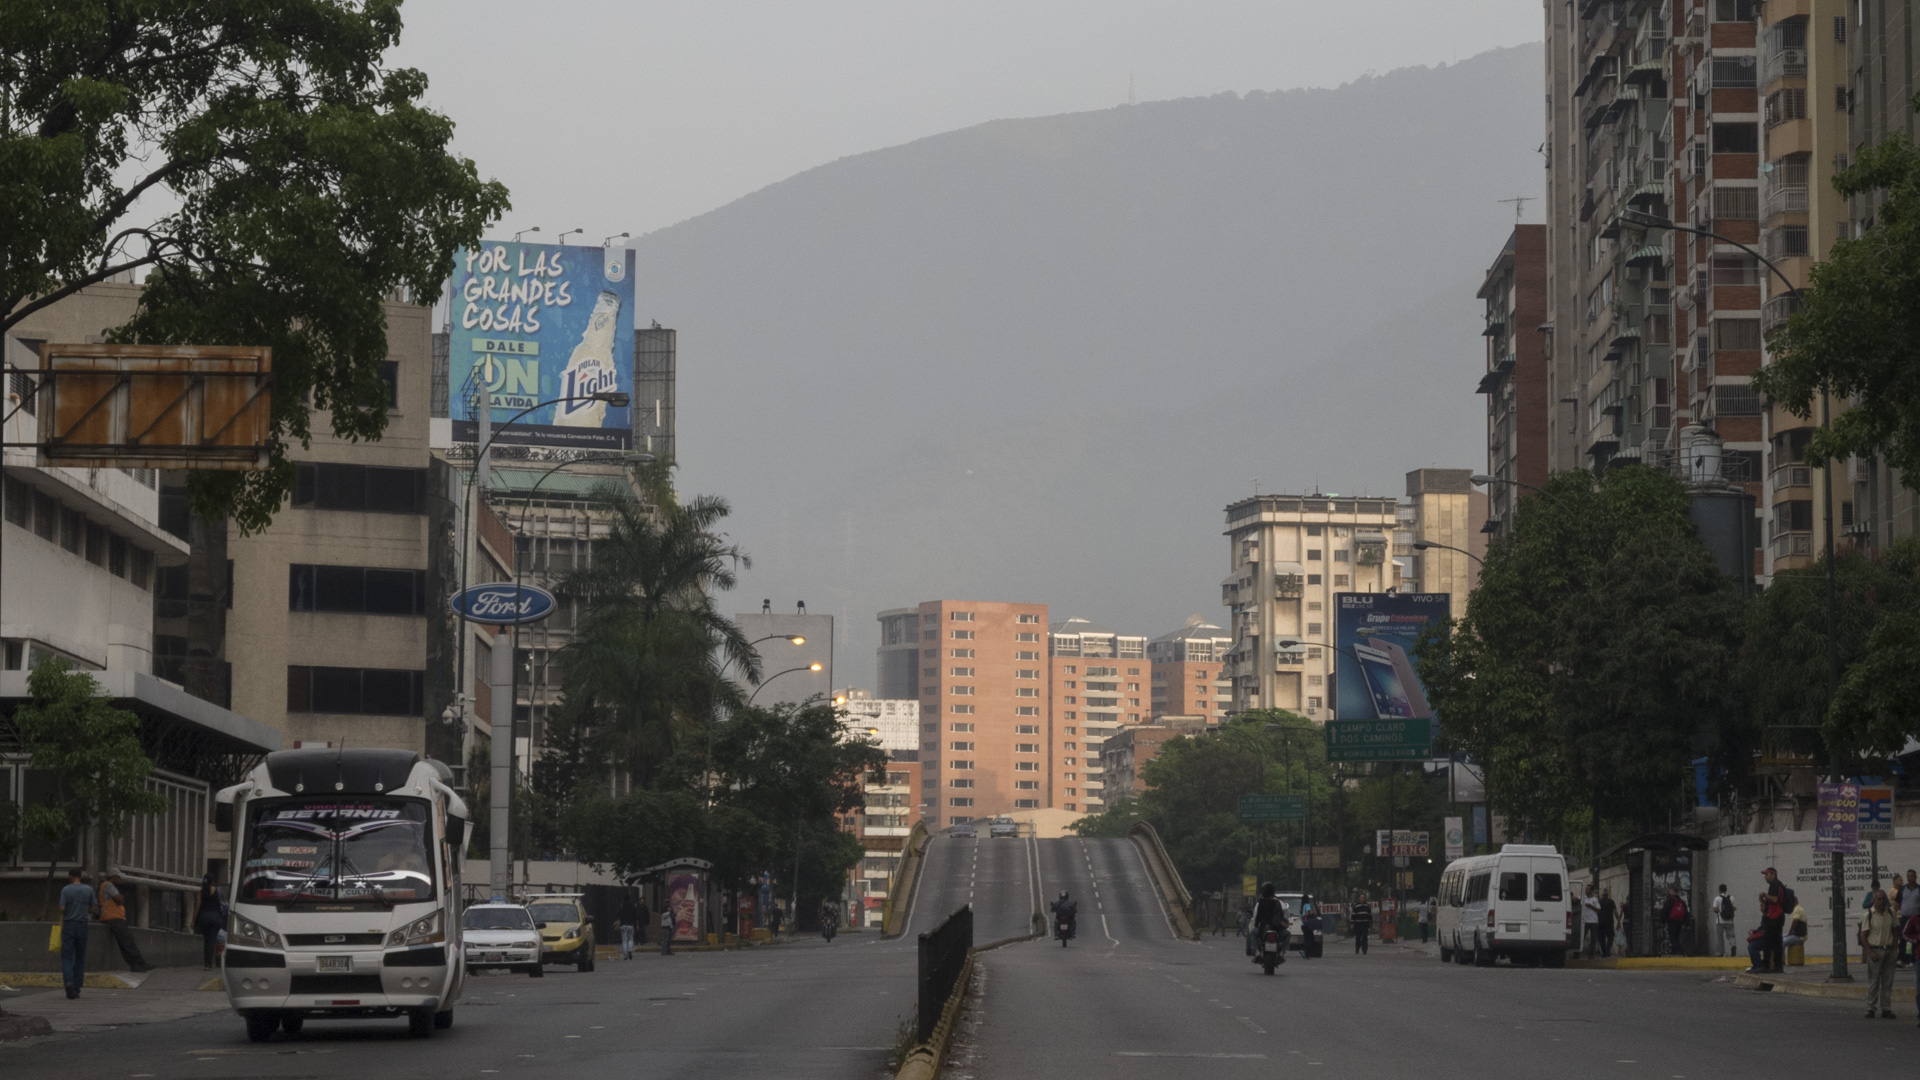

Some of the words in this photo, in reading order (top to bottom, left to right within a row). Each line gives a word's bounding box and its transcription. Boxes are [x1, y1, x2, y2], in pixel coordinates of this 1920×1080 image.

[466, 245, 511, 274] POR
[519, 251, 563, 278] LAS
[464, 276, 572, 307] GRANDES
[462, 302, 541, 334] COSAS
[486, 341, 525, 353] DALE
[579, 360, 601, 373] POLAR
[473, 354, 539, 395] ON
[565, 368, 615, 415] Light
[505, 397, 534, 408] VIDA
[471, 591, 533, 616] Ford
[1342, 596, 1374, 604] BLU
[1412, 595, 1433, 603] VIVO
[1435, 595, 1446, 603] 5R
[1366, 614, 1391, 623] Grupo
[1341, 723, 1372, 734] CAMPO
[1375, 722, 1406, 732] CLARO
[1340, 734, 1359, 744] DOS
[1363, 733, 1404, 743] CAMINOS
[1378, 749, 1416, 757] GALLEGOS
[276, 809, 400, 820] BETANIA
[1382, 845, 1428, 855] TURNO
